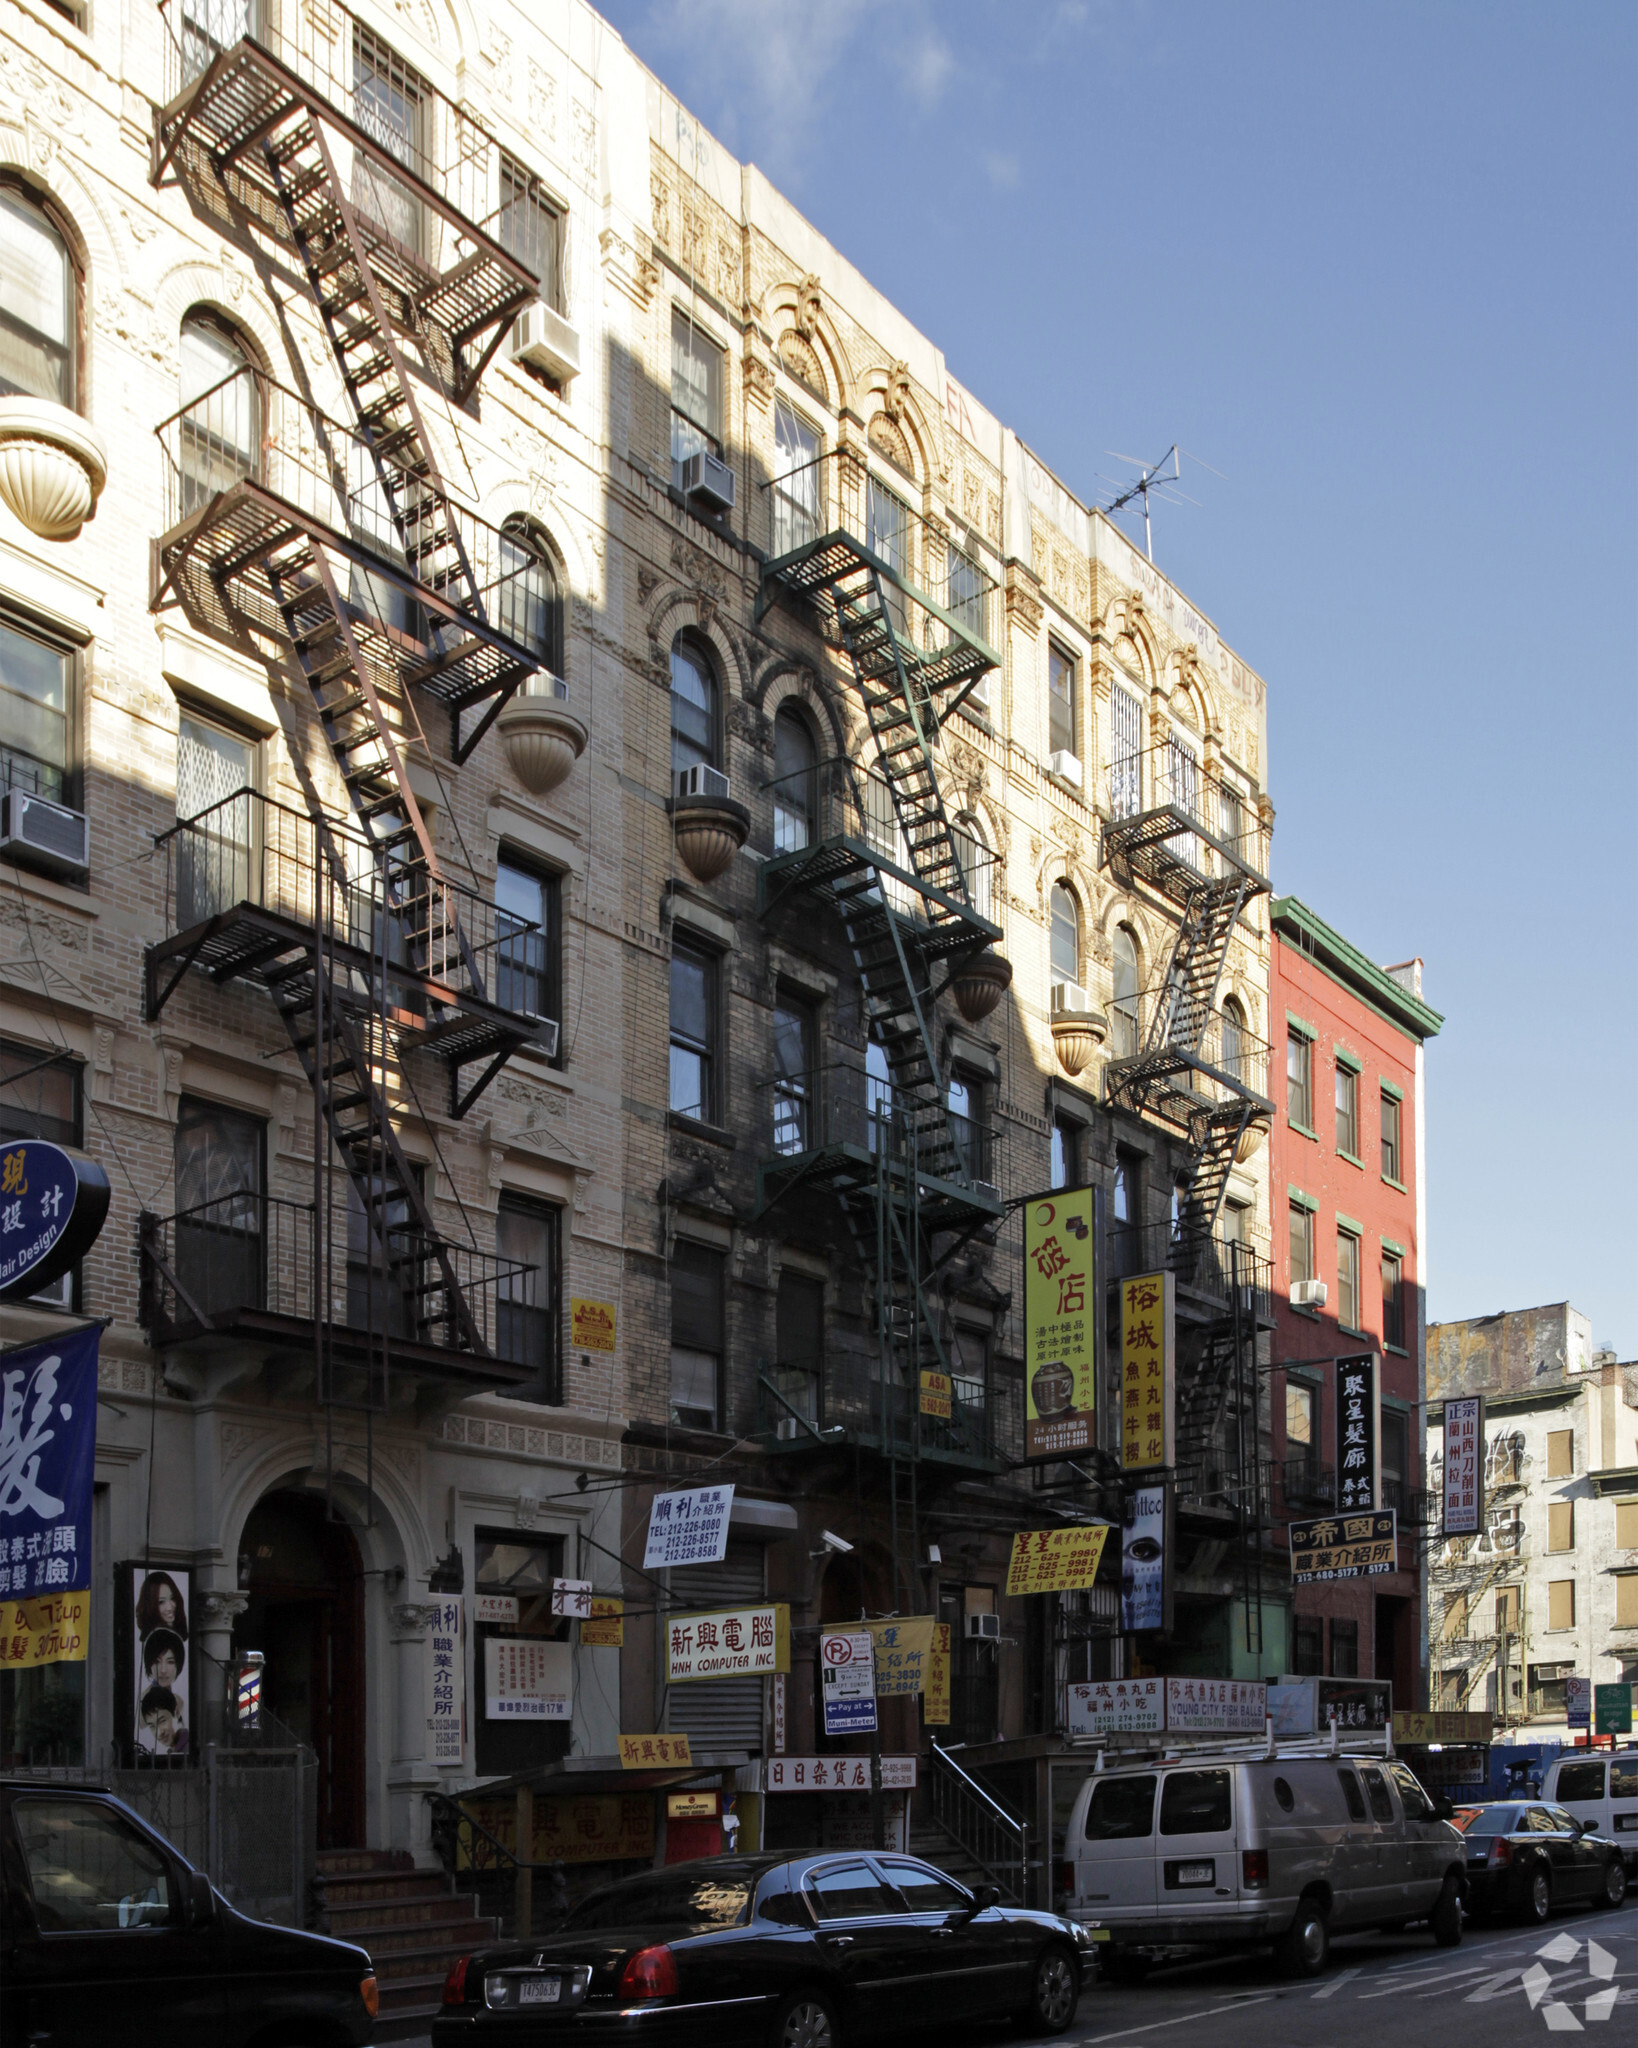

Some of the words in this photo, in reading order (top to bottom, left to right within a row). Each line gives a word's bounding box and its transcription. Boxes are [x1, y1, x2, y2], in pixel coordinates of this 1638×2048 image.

[2, 1184, 64, 1233] 設計
[18, 1224, 57, 1267] Design
[1127, 1283, 1159, 1350] 榕城
[1343, 1375, 1367, 1468] 聚星髮廊
[656, 1496, 692, 1521] 順利
[700, 1491, 721, 1502] 職業
[692, 1502, 726, 1516] 介紹所
[650, 1526, 667, 1537] TEL:
[668, 1518, 721, 1535] 212-226-8080
[1309, 1517, 1375, 1548] 帝國
[666, 1531, 719, 1548] 212-226-8577
[1015, 1531, 1053, 1555] 星星
[664, 1545, 717, 1561] 212-226-8588
[1295, 1542, 1393, 1570] 職業介紹所
[1297, 1566, 1359, 1583] 212-680-5172
[1368, 1562, 1391, 1574] 5173
[671, 1615, 773, 1656] 新興電腦
[672, 1661, 692, 1674] HNH
[697, 1655, 750, 1671] COMPUTER
[755, 1653, 774, 1666] INC.
[433, 1637, 453, 1715] 職業介紹所
[850, 1681, 870, 1689] SUNDAY
[1075, 1682, 1157, 1699] 榕城魚丸店
[838, 1703, 852, 1712] Pay
[1087, 1698, 1147, 1713] 福州小吃
[1172, 1703, 1199, 1715] YOUNG
[1202, 1704, 1219, 1716] CITY
[1222, 1704, 1238, 1716] FISH
[1241, 1705, 1262, 1717] BALLS
[828, 1717, 873, 1728] Muni-Meter
[1071, 1725, 1087, 1734] Tel:
[1118, 1721, 1157, 1731] 613-0988
[1094, 1716, 1115, 1724] (212)
[1118, 1713, 1158, 1723] 274-9702
[623, 1738, 689, 1764] 新興電腦
[773, 1760, 866, 1787] 日日杂货店
[832, 1822, 848, 1831] WE
[851, 1821, 893, 1830] ACCT
[829, 1833, 851, 1842] WIC
[545, 1841, 619, 1857] COMPUTER
